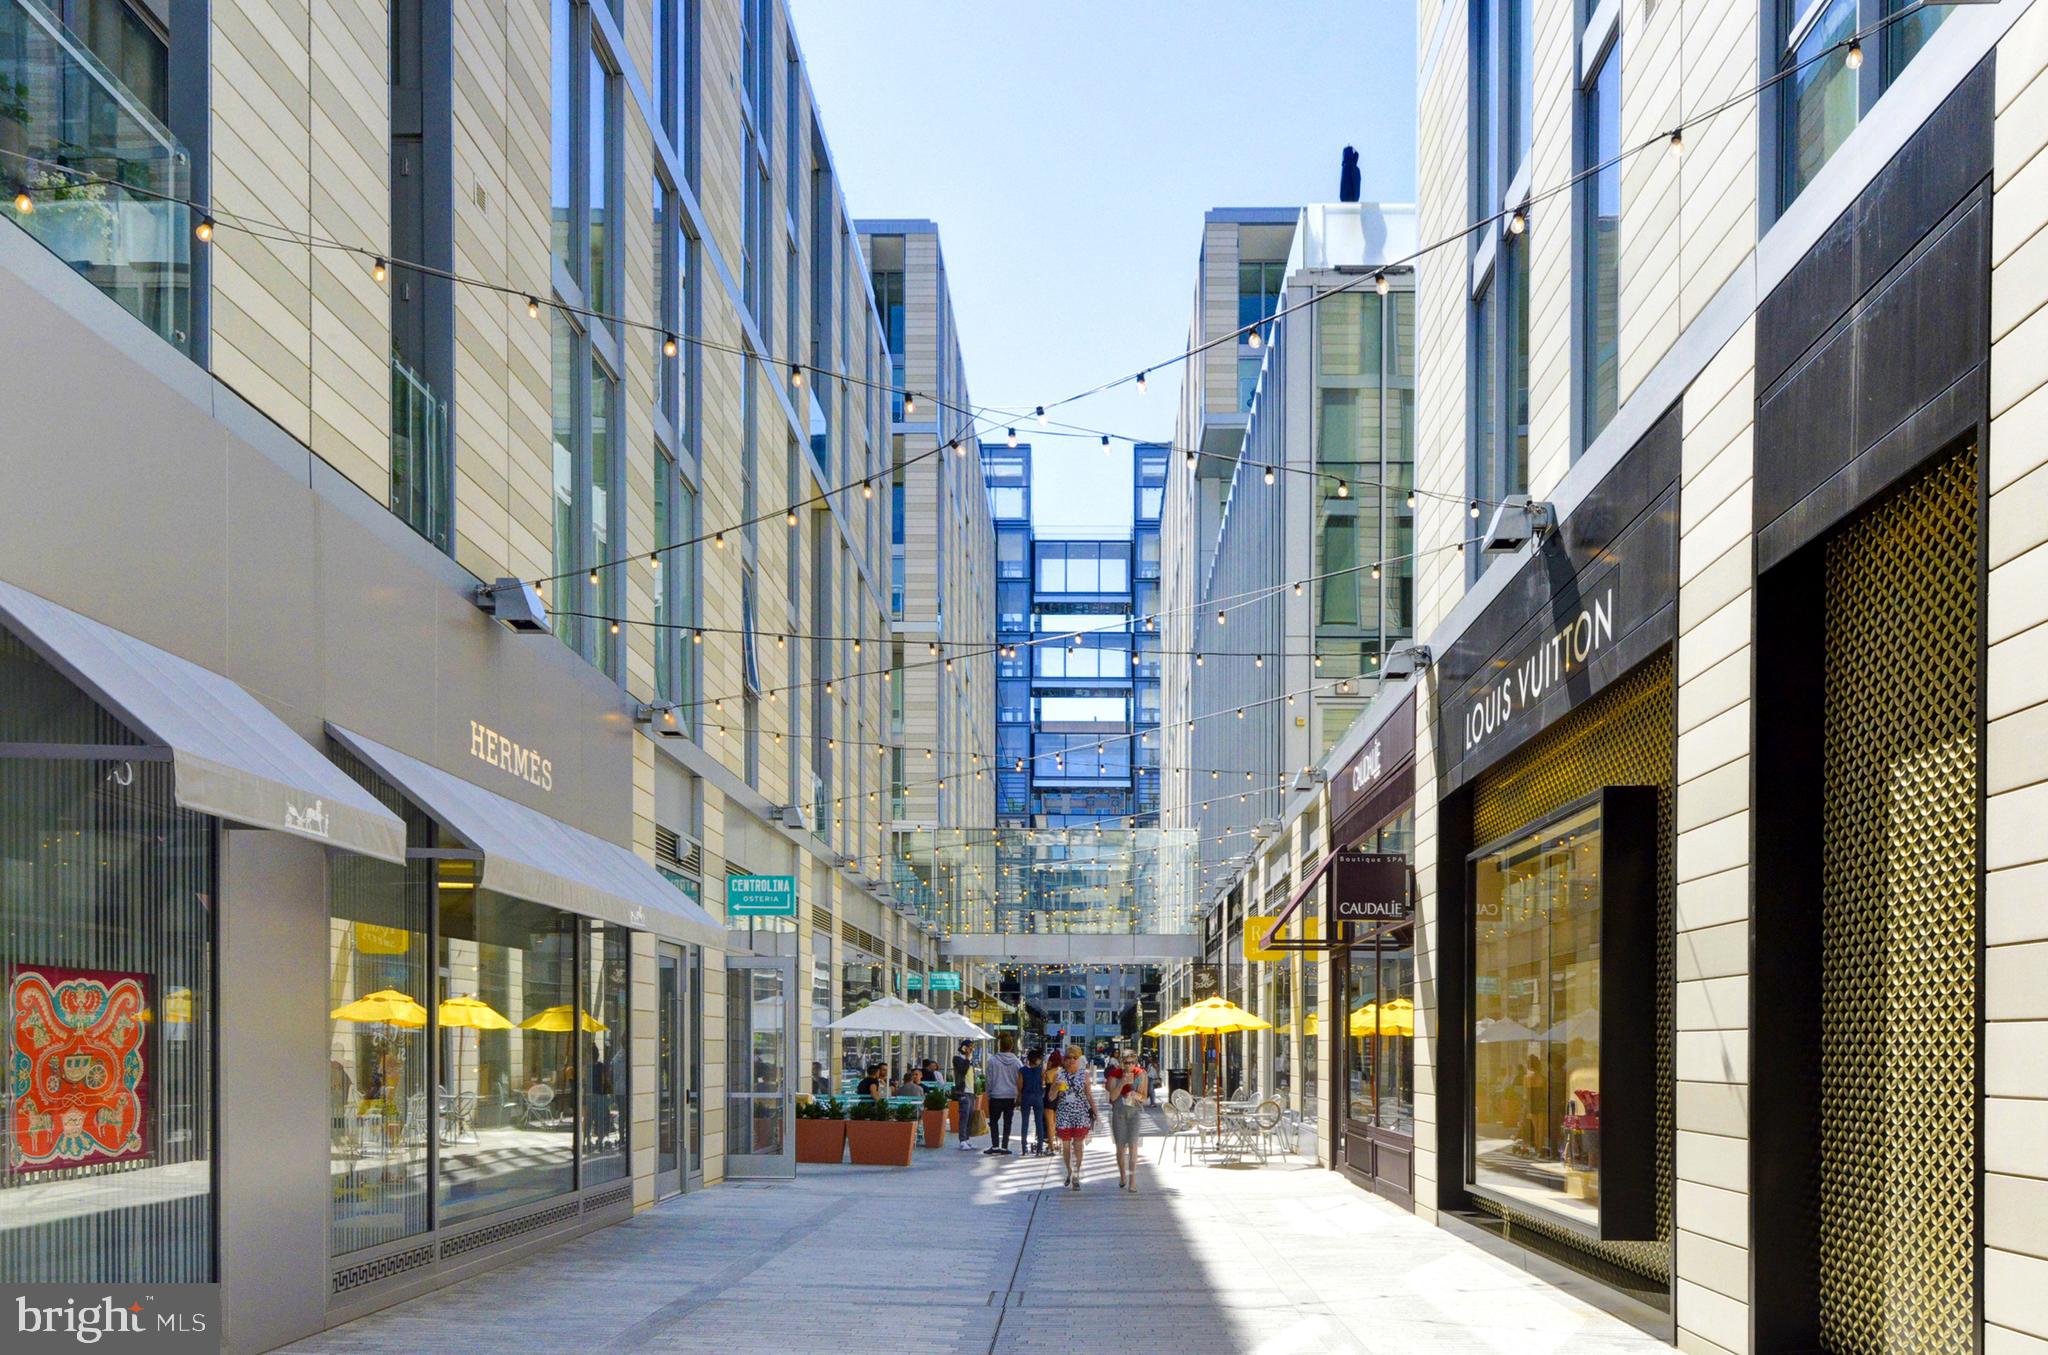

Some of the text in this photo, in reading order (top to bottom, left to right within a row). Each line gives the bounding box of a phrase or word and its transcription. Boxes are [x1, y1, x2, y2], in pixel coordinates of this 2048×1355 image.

[1466, 589, 1612, 750] LOUIS VUITTON
[470, 720, 552, 791] HERMÈS
[731, 879, 790, 892] CENTROLINA
